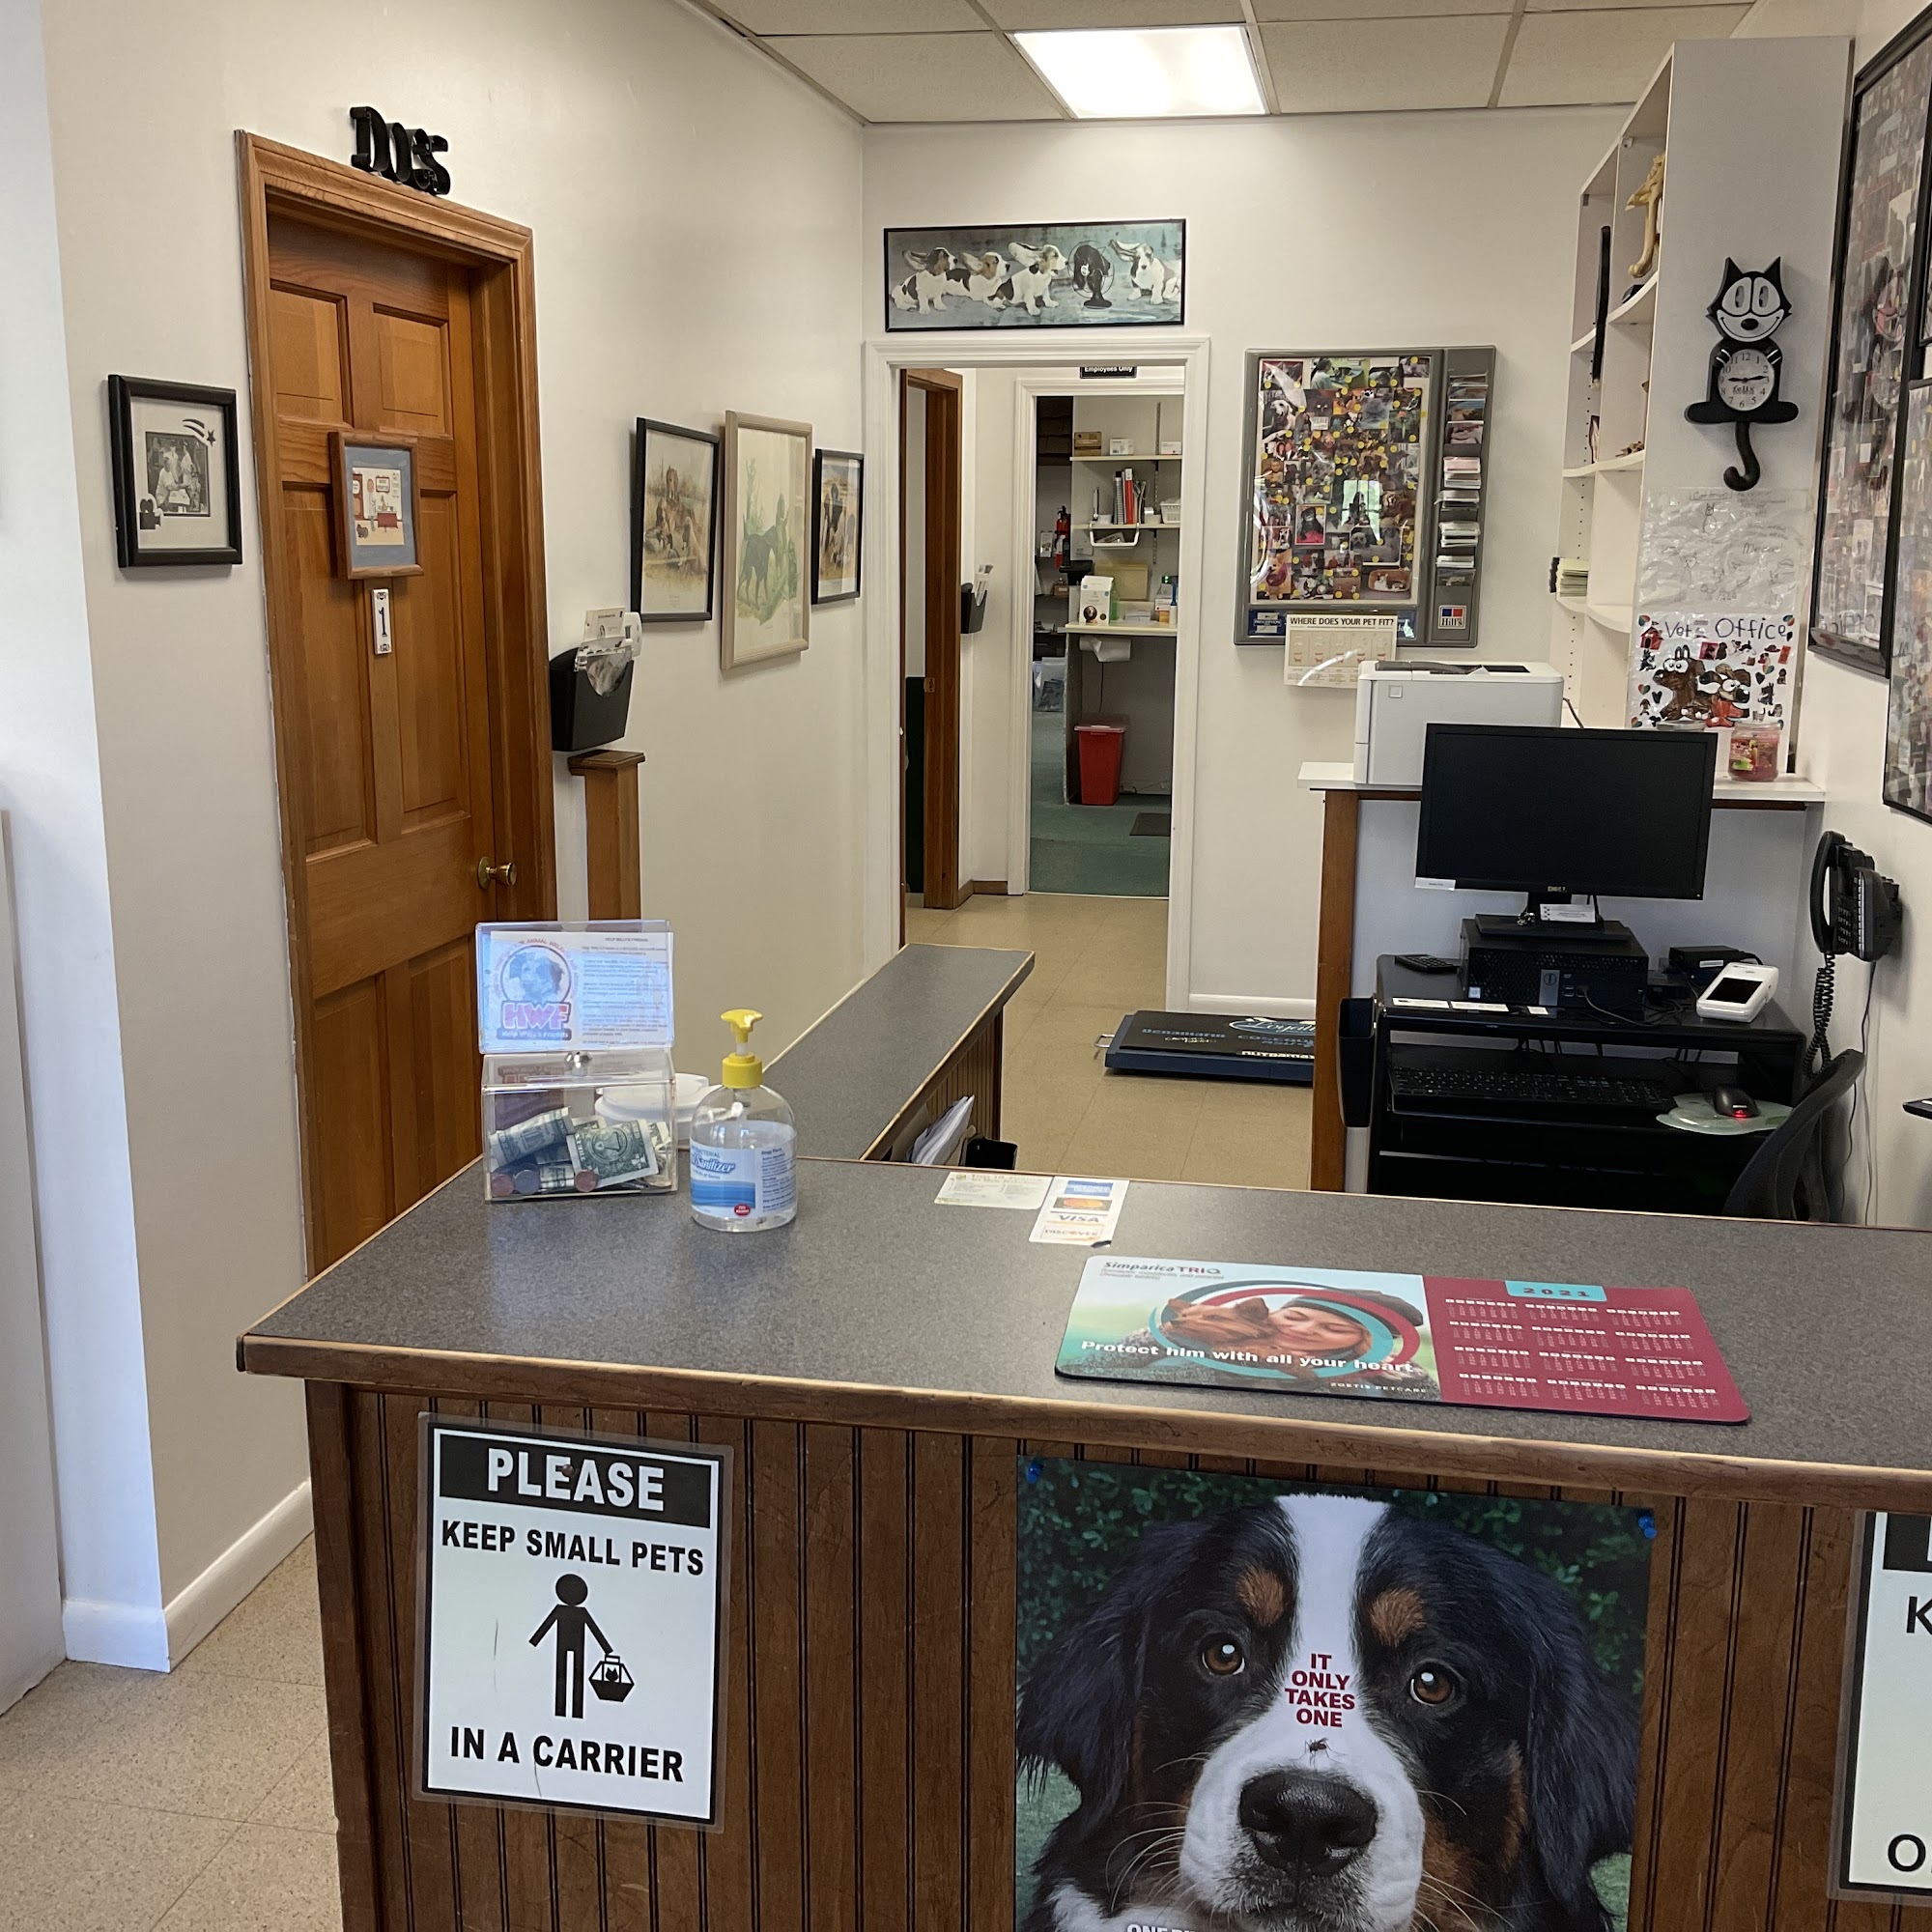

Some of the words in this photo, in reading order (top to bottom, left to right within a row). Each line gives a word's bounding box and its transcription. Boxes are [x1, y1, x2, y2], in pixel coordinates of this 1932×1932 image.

[379, 607, 388, 638] 1
[1290, 617, 1318, 626] WHERE
[1319, 617, 1339, 626] DOES
[1341, 617, 1361, 626] YOUR
[1363, 617, 1377, 626] PET
[1378, 617, 1395, 626] FIT?
[1442, 617, 1463, 627] Hill's
[1665, 621, 1691, 638] Vet
[1715, 617, 1788, 639] Office
[503, 1002, 569, 1030] HWF
[696, 1154, 735, 1173] Sanitizer
[1104, 1261, 1175, 1272] Simparica
[1522, 1287, 1590, 1297] 2021
[1081, 1340, 1159, 1356] Protect
[1166, 1345, 1205, 1359] him
[1212, 1349, 1259, 1363] with
[1265, 1351, 1293, 1365] all
[1299, 1356, 1347, 1372] your
[1353, 1358, 1414, 1374] heart
[487, 1448, 666, 1512] PLEASE
[441, 1520, 516, 1553] KEEP
[526, 1527, 621, 1567] SMALL
[632, 1542, 704, 1577] PETS
[1311, 1653, 1332, 1670] IT
[1292, 1670, 1350, 1690] ONLY
[1285, 1688, 1355, 1711] TAKES
[1296, 1708, 1343, 1728] ONE
[450, 1726, 485, 1760] IN
[497, 1731, 520, 1764] A
[533, 1735, 684, 1782] CARRIER
